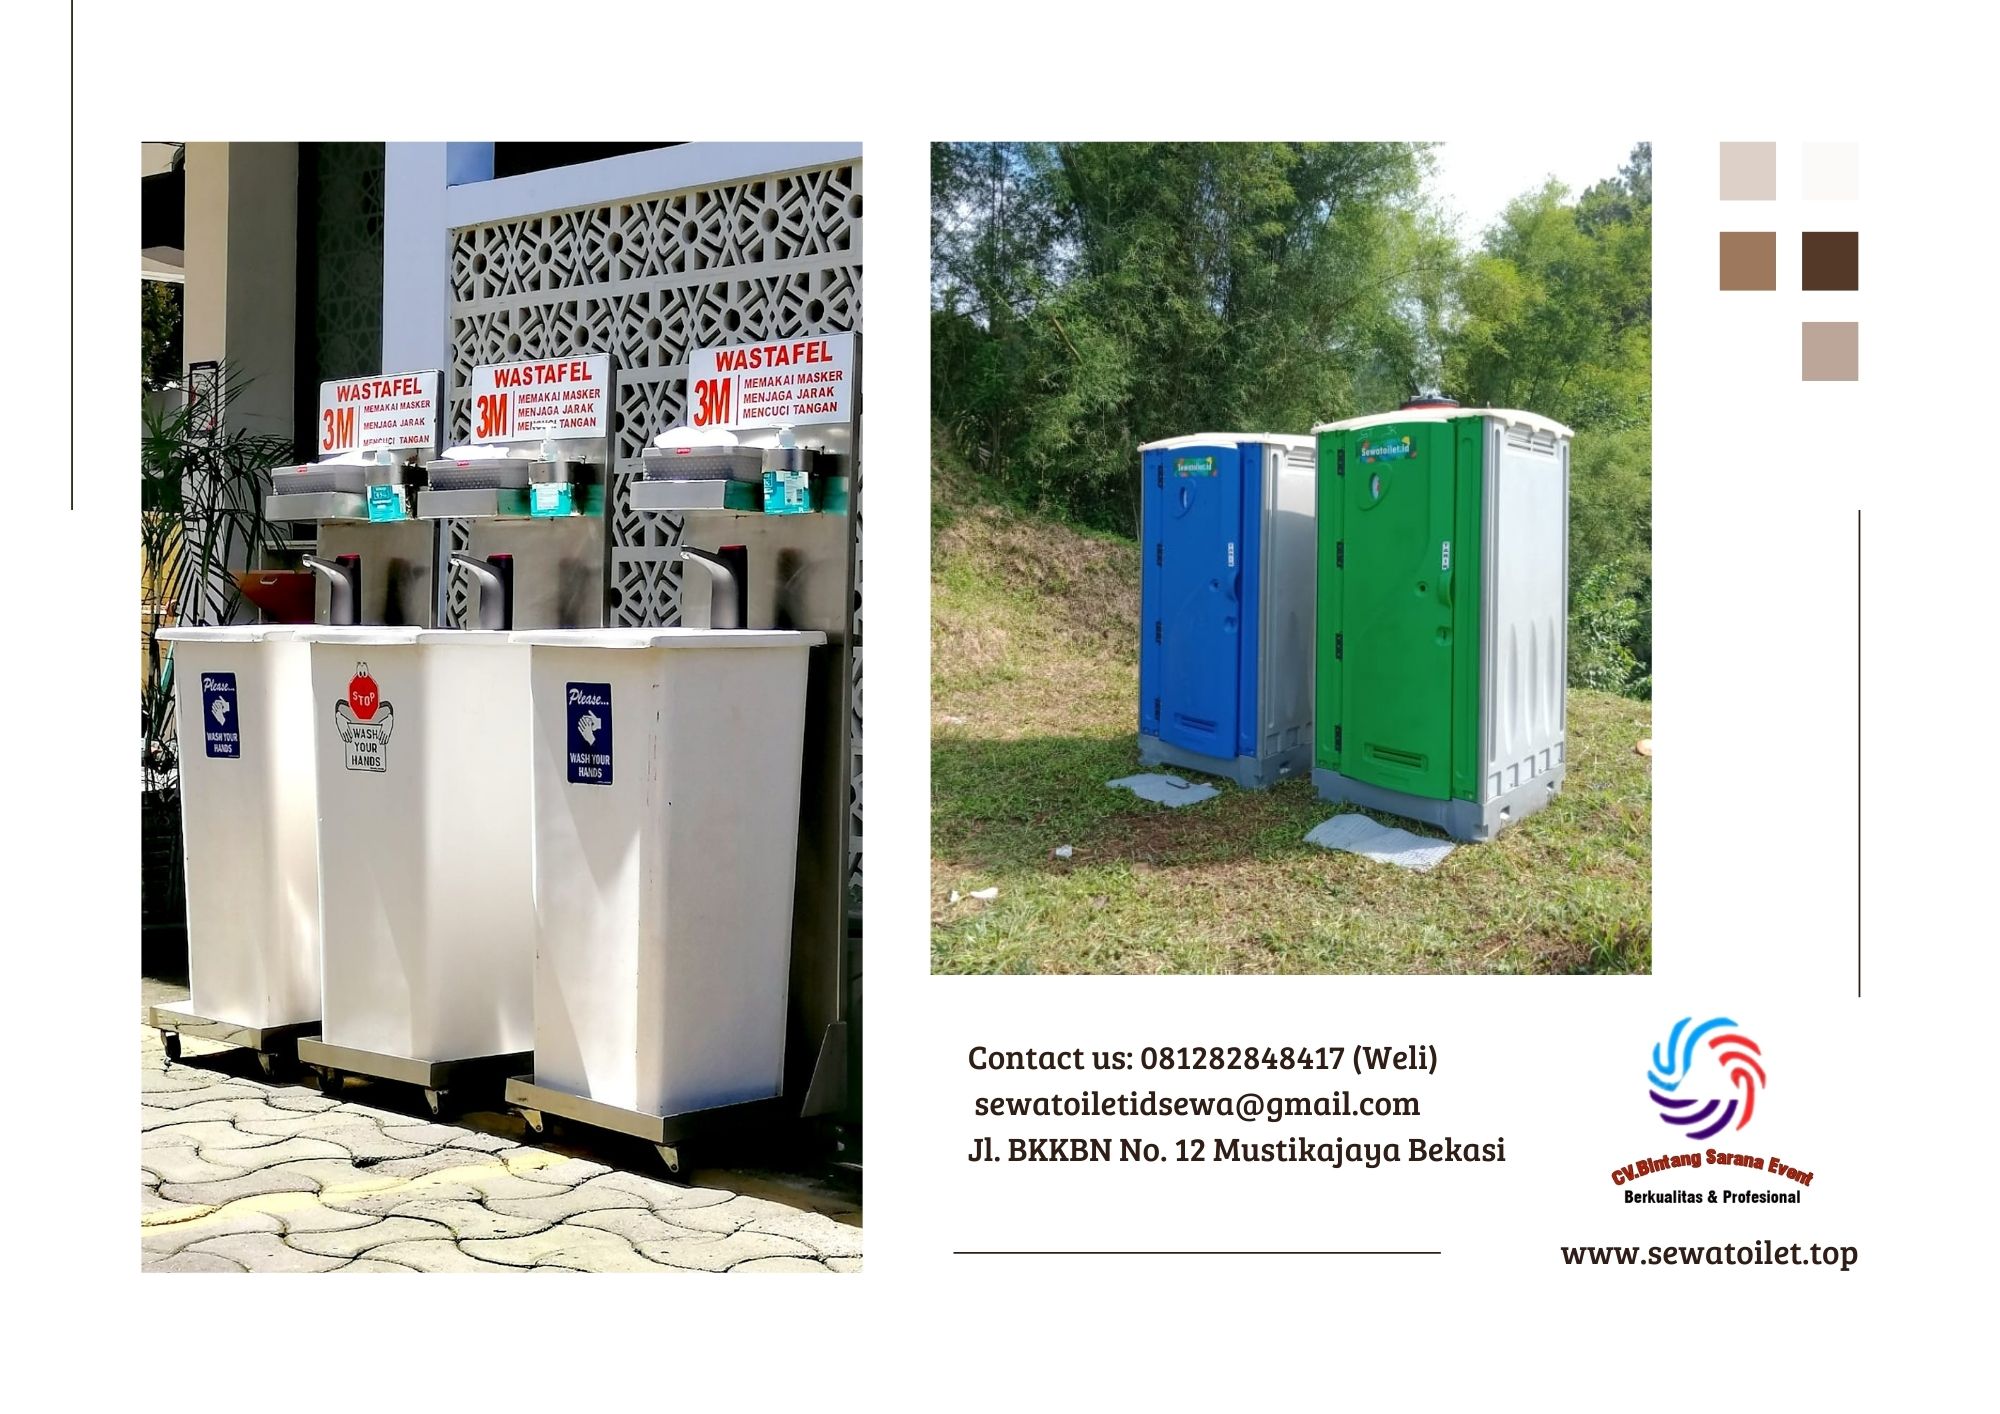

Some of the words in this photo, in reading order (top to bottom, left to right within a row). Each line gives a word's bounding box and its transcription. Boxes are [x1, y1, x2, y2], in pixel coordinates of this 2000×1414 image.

[716, 341, 832, 372] WASTAFEL
[494, 361, 592, 388] WASTAFEL
[744, 375, 794, 388] MEMAKAI
[798, 371, 843, 384] MASKER
[337, 377, 422, 402] WASTAFEL
[518, 392, 560, 404] MEMAKAI
[563, 389, 600, 400] MASKER
[743, 391, 792, 404] MENJAGA
[797, 387, 834, 399] JARAK
[364, 403, 398, 413] MEMAKAI
[400, 400, 431, 410] MASKER
[694, 378, 731, 427] 3M
[477, 394, 508, 438] 3M
[518, 406, 559, 417] MENJAGA
[563, 403, 594, 414] JARAK
[743, 406, 789, 418] MENCUCI
[794, 402, 837, 414] TANGAN
[323, 407, 354, 450] 3M
[364, 420, 397, 430] MENJAGA
[400, 418, 425, 427] JARAK
[560, 417, 596, 428] TANGAN
[400, 435, 430, 444] TANGAN
[352, 691, 375, 706] STOP
[207, 732, 222, 741] WASH
[223, 733, 238, 742] YOUR
[353, 728, 378, 739] WASH
[214, 744, 232, 753] HANDS
[355, 742, 377, 753] YOUR
[352, 755, 381, 766] HANDS
[570, 752, 590, 764] WASH
[592, 754, 610, 765] YOUR
[579, 767, 602, 778] HANDS
